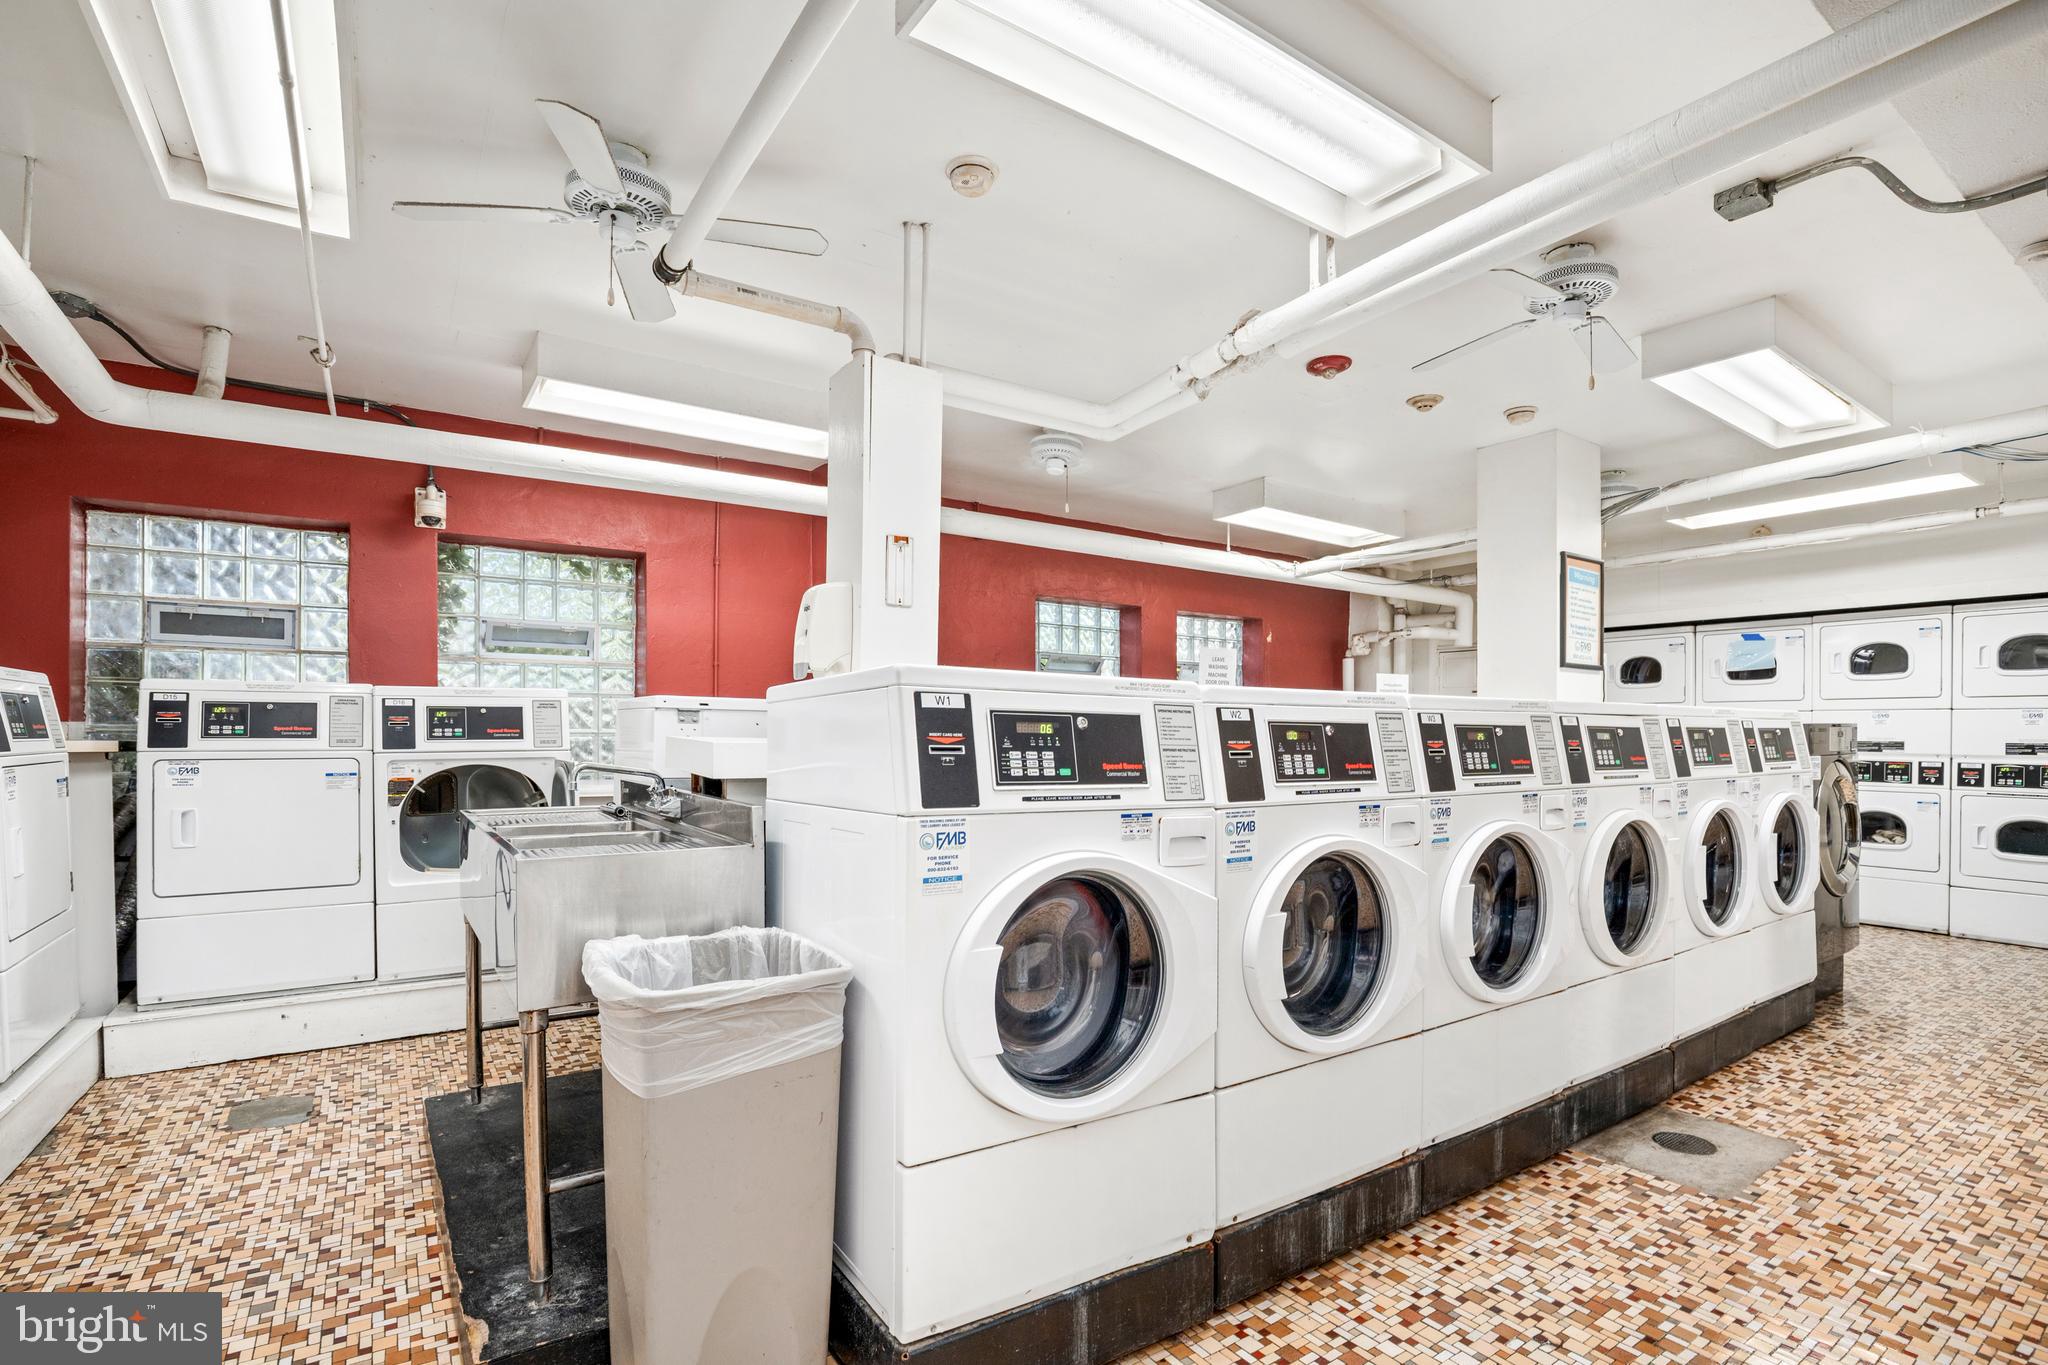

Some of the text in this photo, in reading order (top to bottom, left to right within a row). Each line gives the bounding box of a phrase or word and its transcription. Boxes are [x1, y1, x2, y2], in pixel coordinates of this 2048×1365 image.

[935, 695, 951, 706] W1
[1229, 710, 1242, 719] W2
[1040, 723, 1052, 734] 06
[178, 766, 200, 776] FMB
[1236, 820, 1256, 836] FMB
[936, 831, 967, 850] FMB
[928, 875, 957, 883] NOTICE
